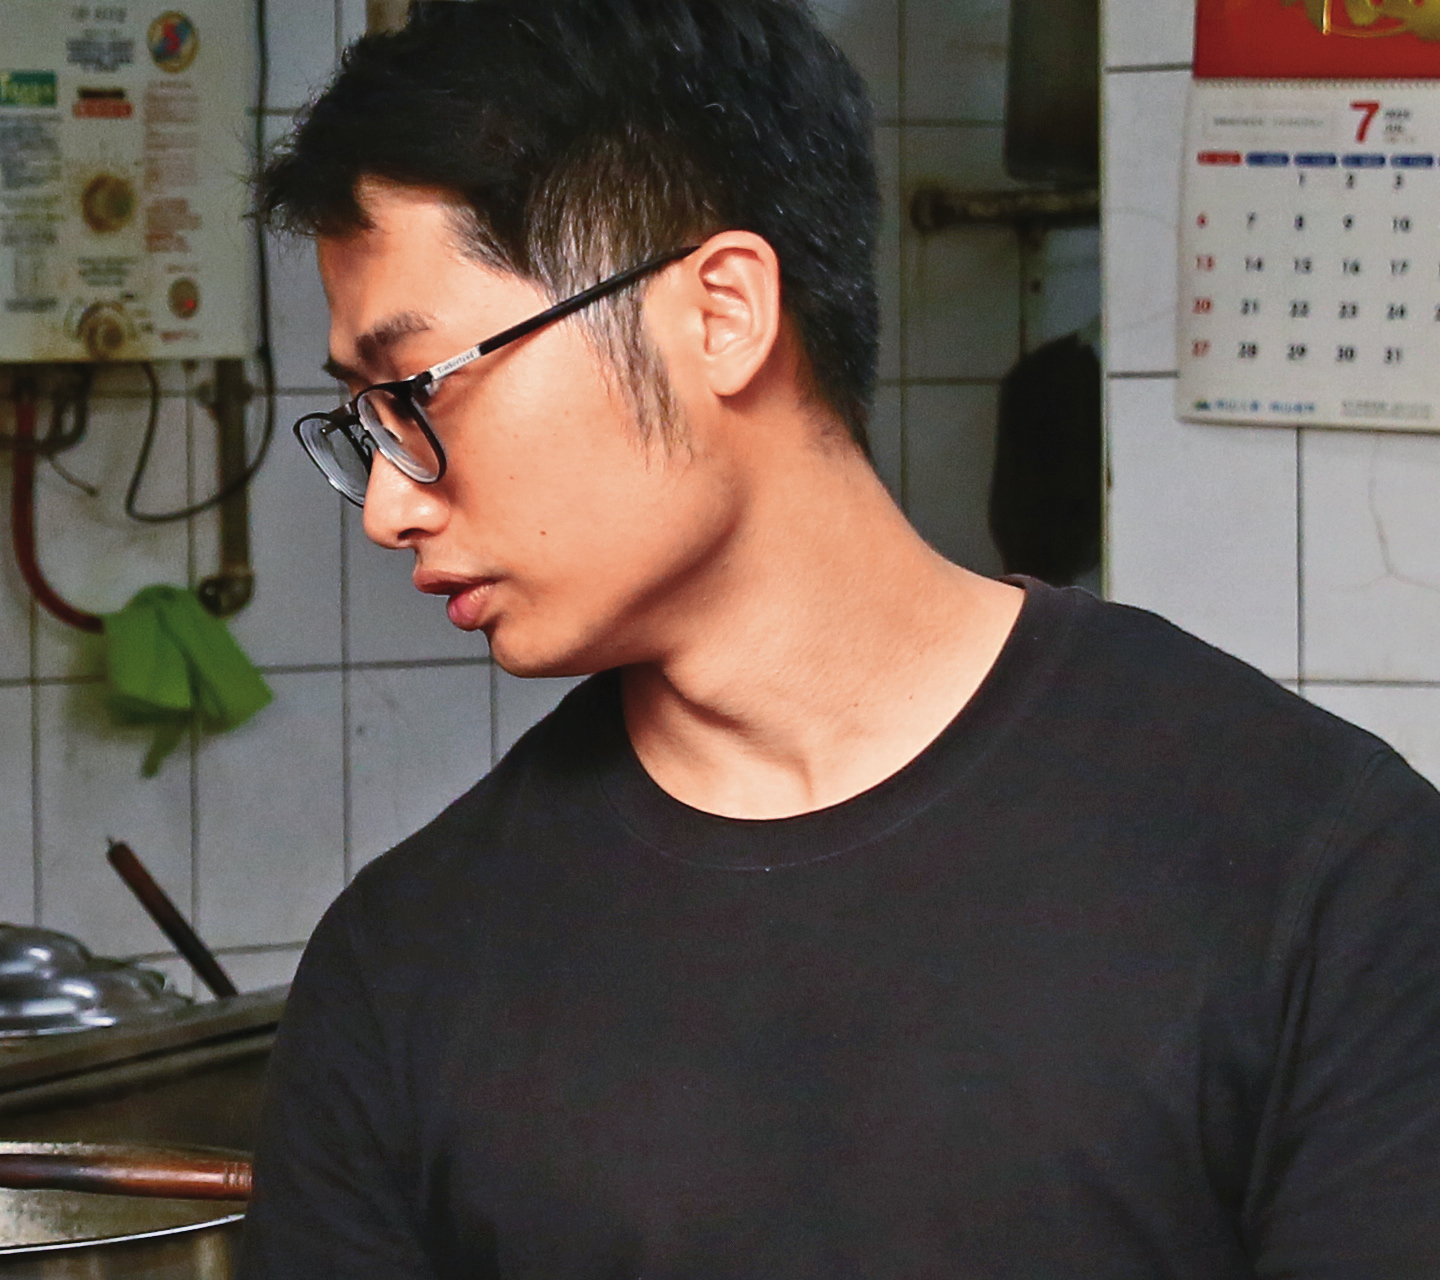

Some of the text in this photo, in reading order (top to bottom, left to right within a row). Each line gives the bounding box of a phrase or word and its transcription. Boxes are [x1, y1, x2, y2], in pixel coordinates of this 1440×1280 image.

[1350, 101, 1380, 143] 7
[1297, 171, 1307, 187] 1
[1246, 211, 1257, 227] 7
[1393, 218, 1411, 232] 10
[1245, 258, 1264, 272] 14
[1343, 261, 1361, 274] 16
[1390, 260, 1409, 274] 17
[1193, 298, 1213, 314] 20
[1241, 299, 1259, 316] 21
[1290, 301, 1309, 318] 22
[1339, 303, 1358, 319] 23
[1387, 305, 1407, 320] 24
[1191, 339, 1402, 364] 27 28 29 30 31
